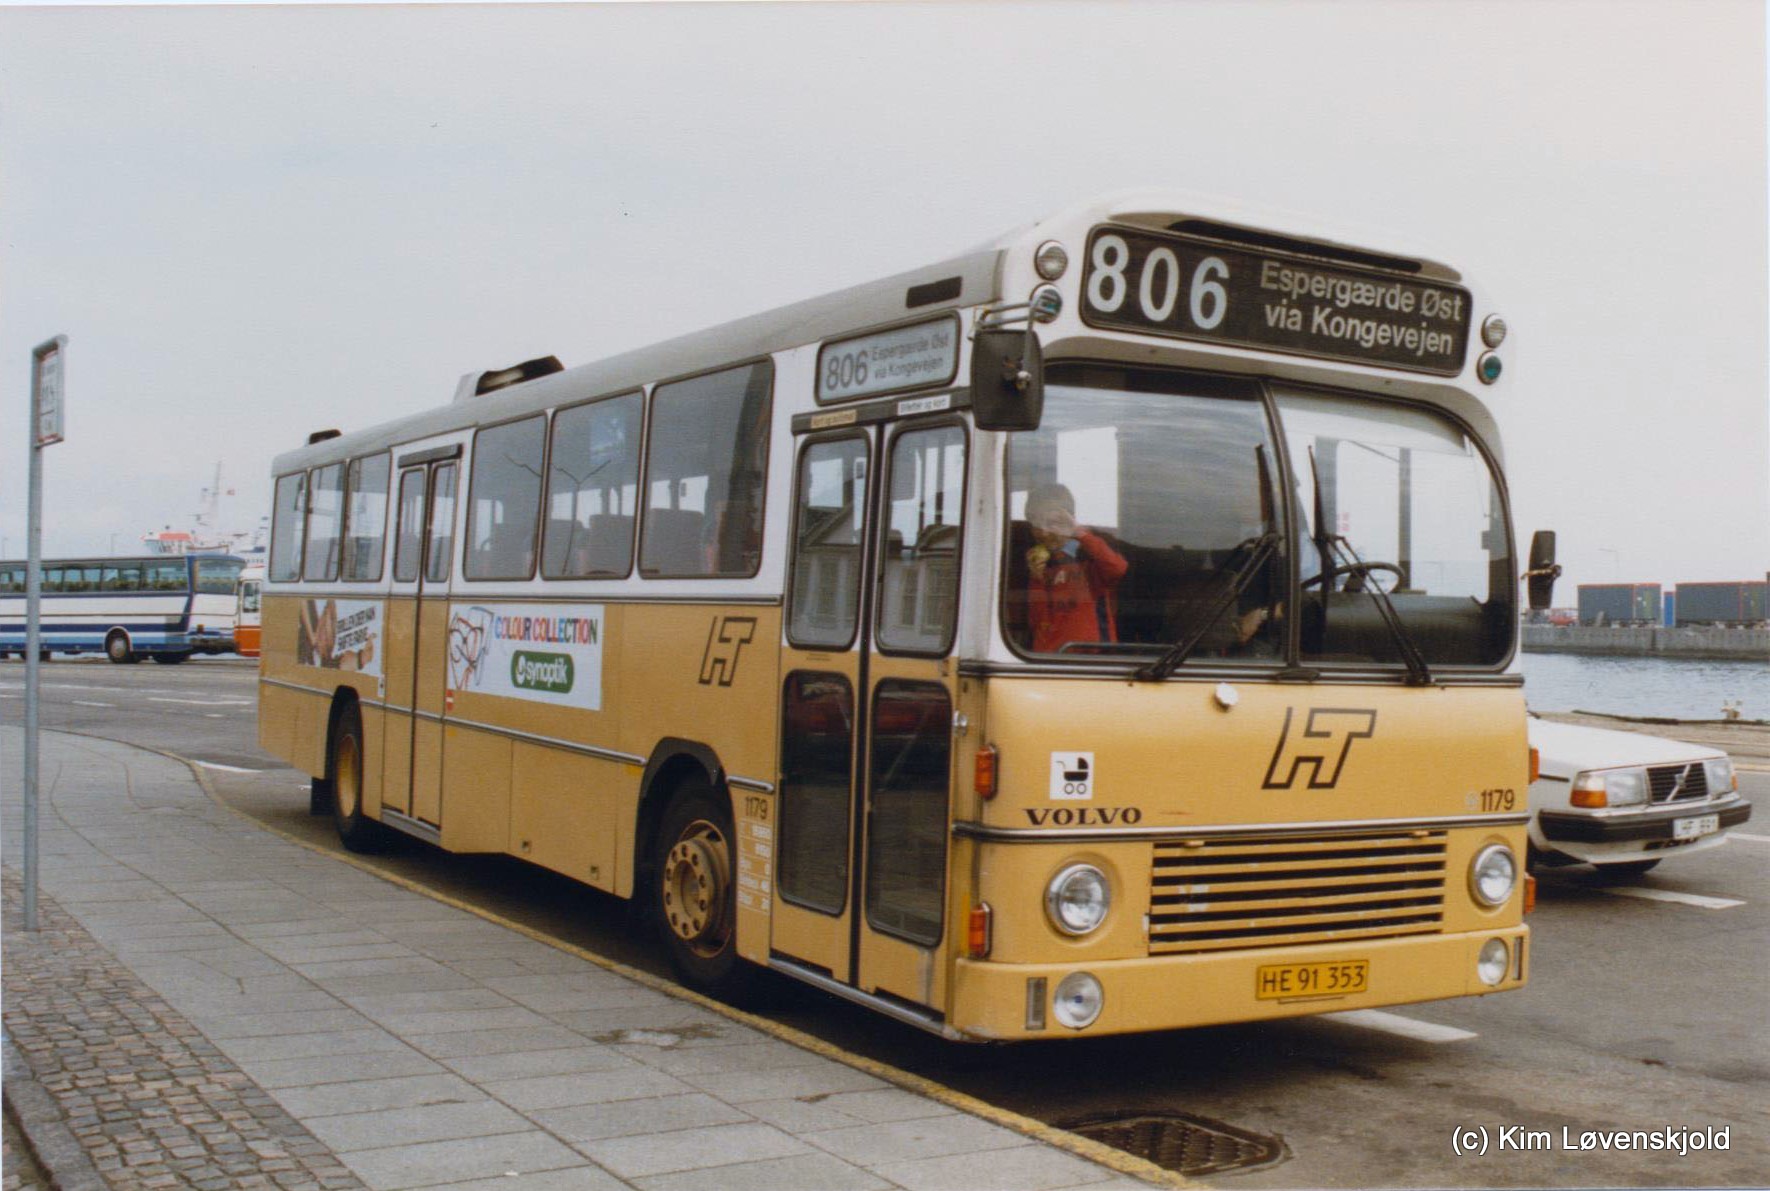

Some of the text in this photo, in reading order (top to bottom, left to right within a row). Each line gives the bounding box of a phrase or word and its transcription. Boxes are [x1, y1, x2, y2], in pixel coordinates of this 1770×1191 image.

[1087, 234, 1231, 330] 806
[1260, 260, 1463, 322] Espergærde Øst
[1264, 301, 1454, 356] via Kongevejen
[826, 350, 868, 392] 806
[494, 615, 598, 645] COLOUR COLLECTION
[745, 795, 768, 820] 1179
[1480, 788, 1516, 812] 1179
[1021, 806, 1142, 827] VOLVO
[1262, 965, 1365, 993] HE 91 353
